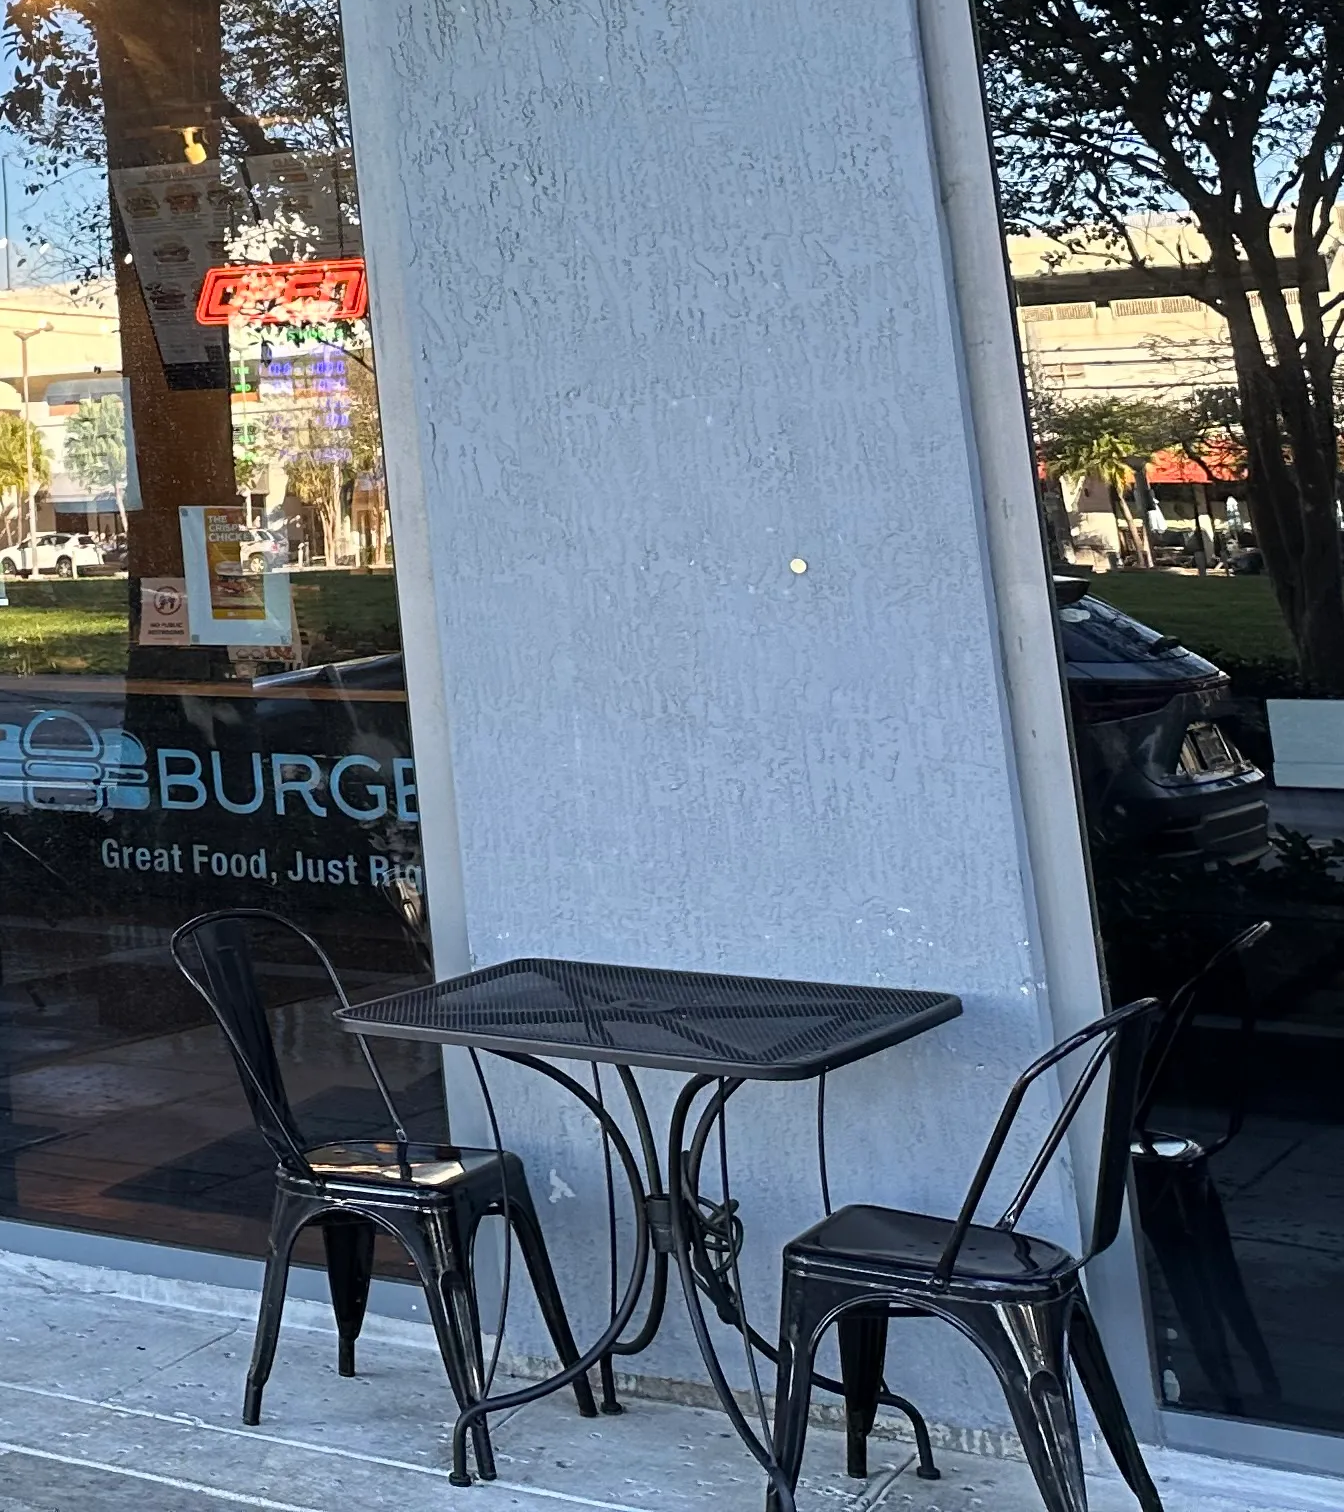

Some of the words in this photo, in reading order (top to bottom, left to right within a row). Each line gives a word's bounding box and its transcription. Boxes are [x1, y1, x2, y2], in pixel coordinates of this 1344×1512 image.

[208, 532, 254, 542] CHICKE
[101, 838, 184, 874] Great
[192, 844, 278, 886] Food,
[287, 850, 358, 886] Just
